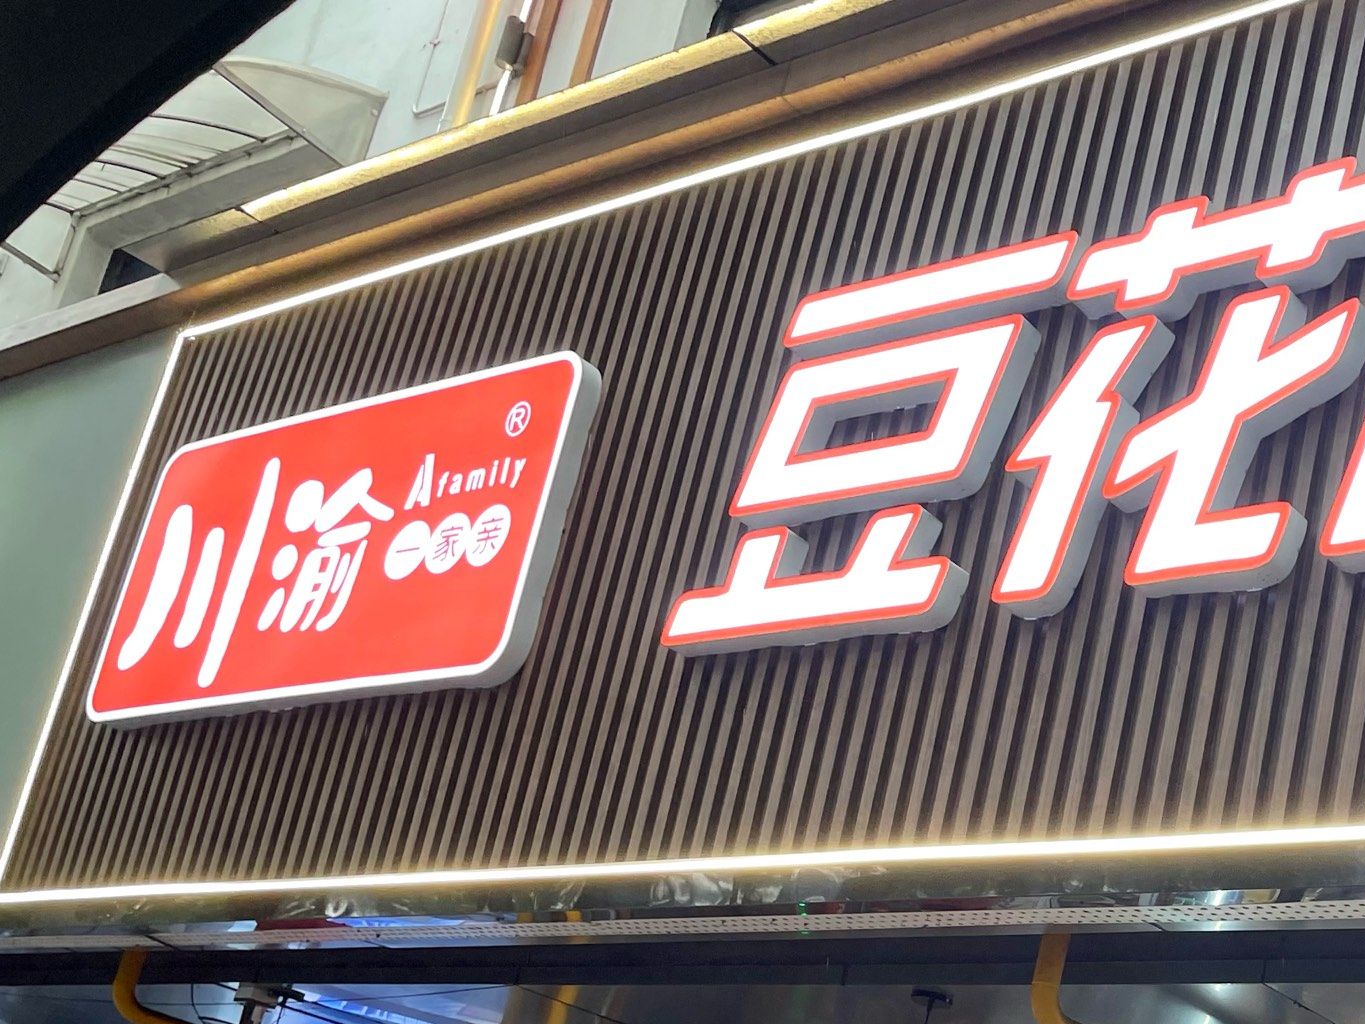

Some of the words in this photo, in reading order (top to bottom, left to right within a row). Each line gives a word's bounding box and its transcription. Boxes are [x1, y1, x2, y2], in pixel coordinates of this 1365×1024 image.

[117, 457, 394, 688] 川渝
[385, 504, 511, 579] 一家亲
